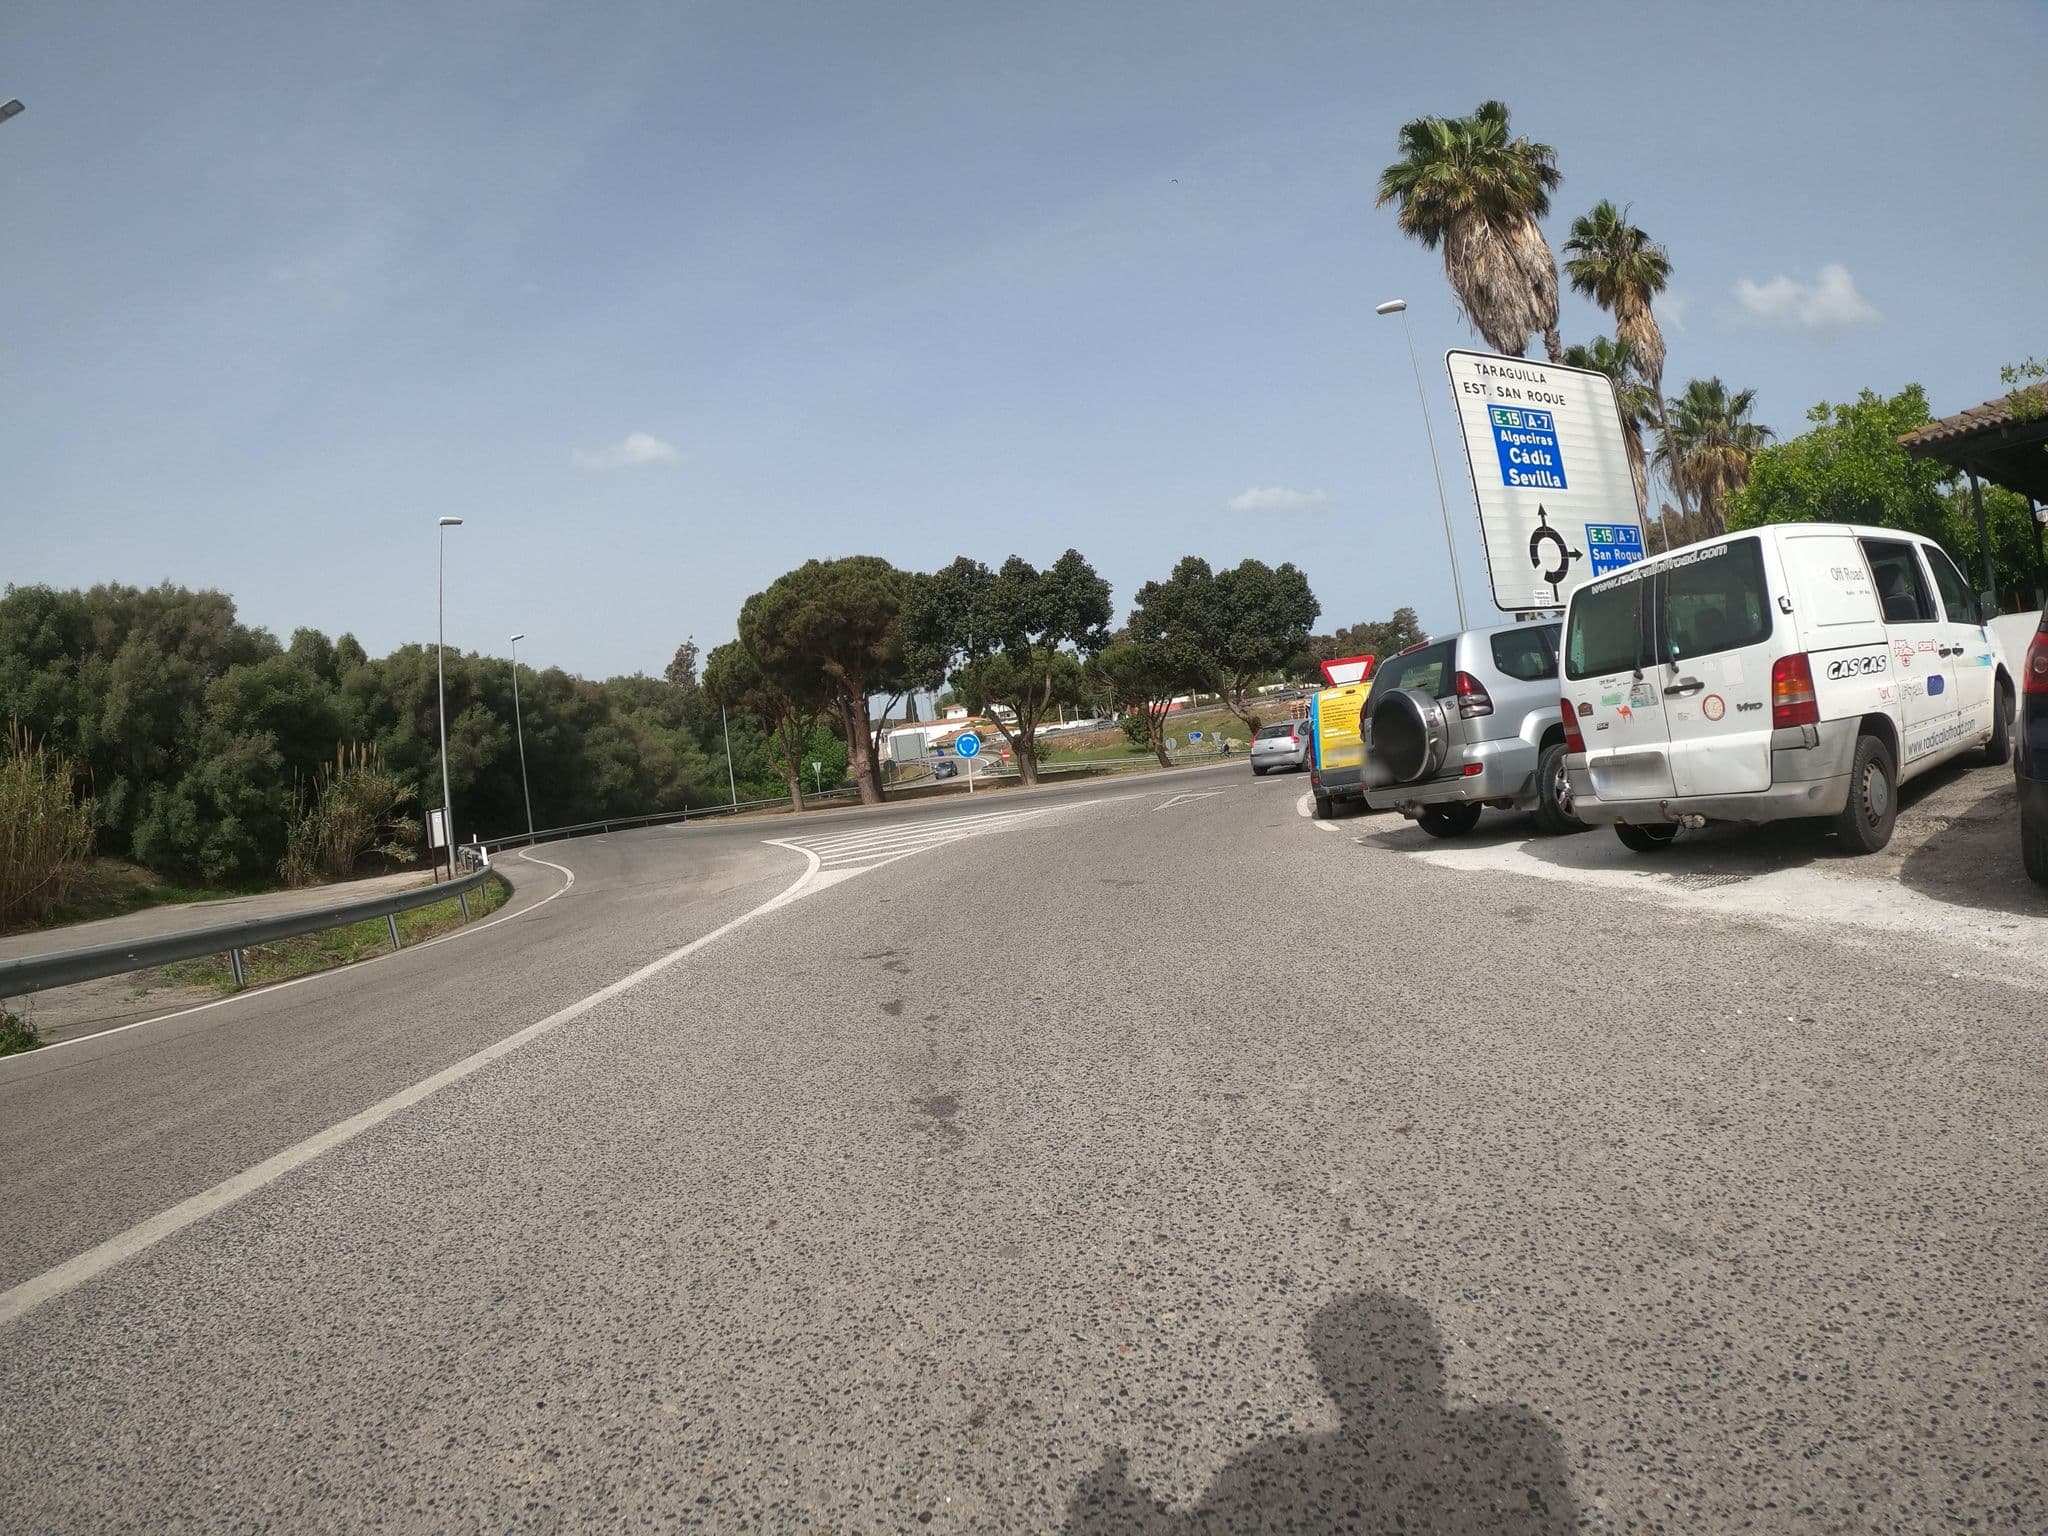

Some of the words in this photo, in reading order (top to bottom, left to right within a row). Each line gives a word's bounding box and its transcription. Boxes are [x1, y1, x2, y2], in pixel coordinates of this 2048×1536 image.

[1474, 363, 1547, 384] TARAGUILLA
[1463, 382, 1492, 396] EST.
[1496, 386, 1521, 400] SAN
[1527, 390, 1566, 406] ROQUE
[1493, 410, 1521, 426] E-15
[1528, 414, 1549, 429] A-7
[1501, 430, 1554, 446] Algeciras
[1509, 447, 1553, 466] Cádiz
[1508, 468, 1562, 488] Sevilla
[1590, 528, 1613, 542] E-15
[1619, 530, 1636, 543] A-7
[1592, 548, 1612, 561] San
[1614, 548, 1643, 563] Roque
